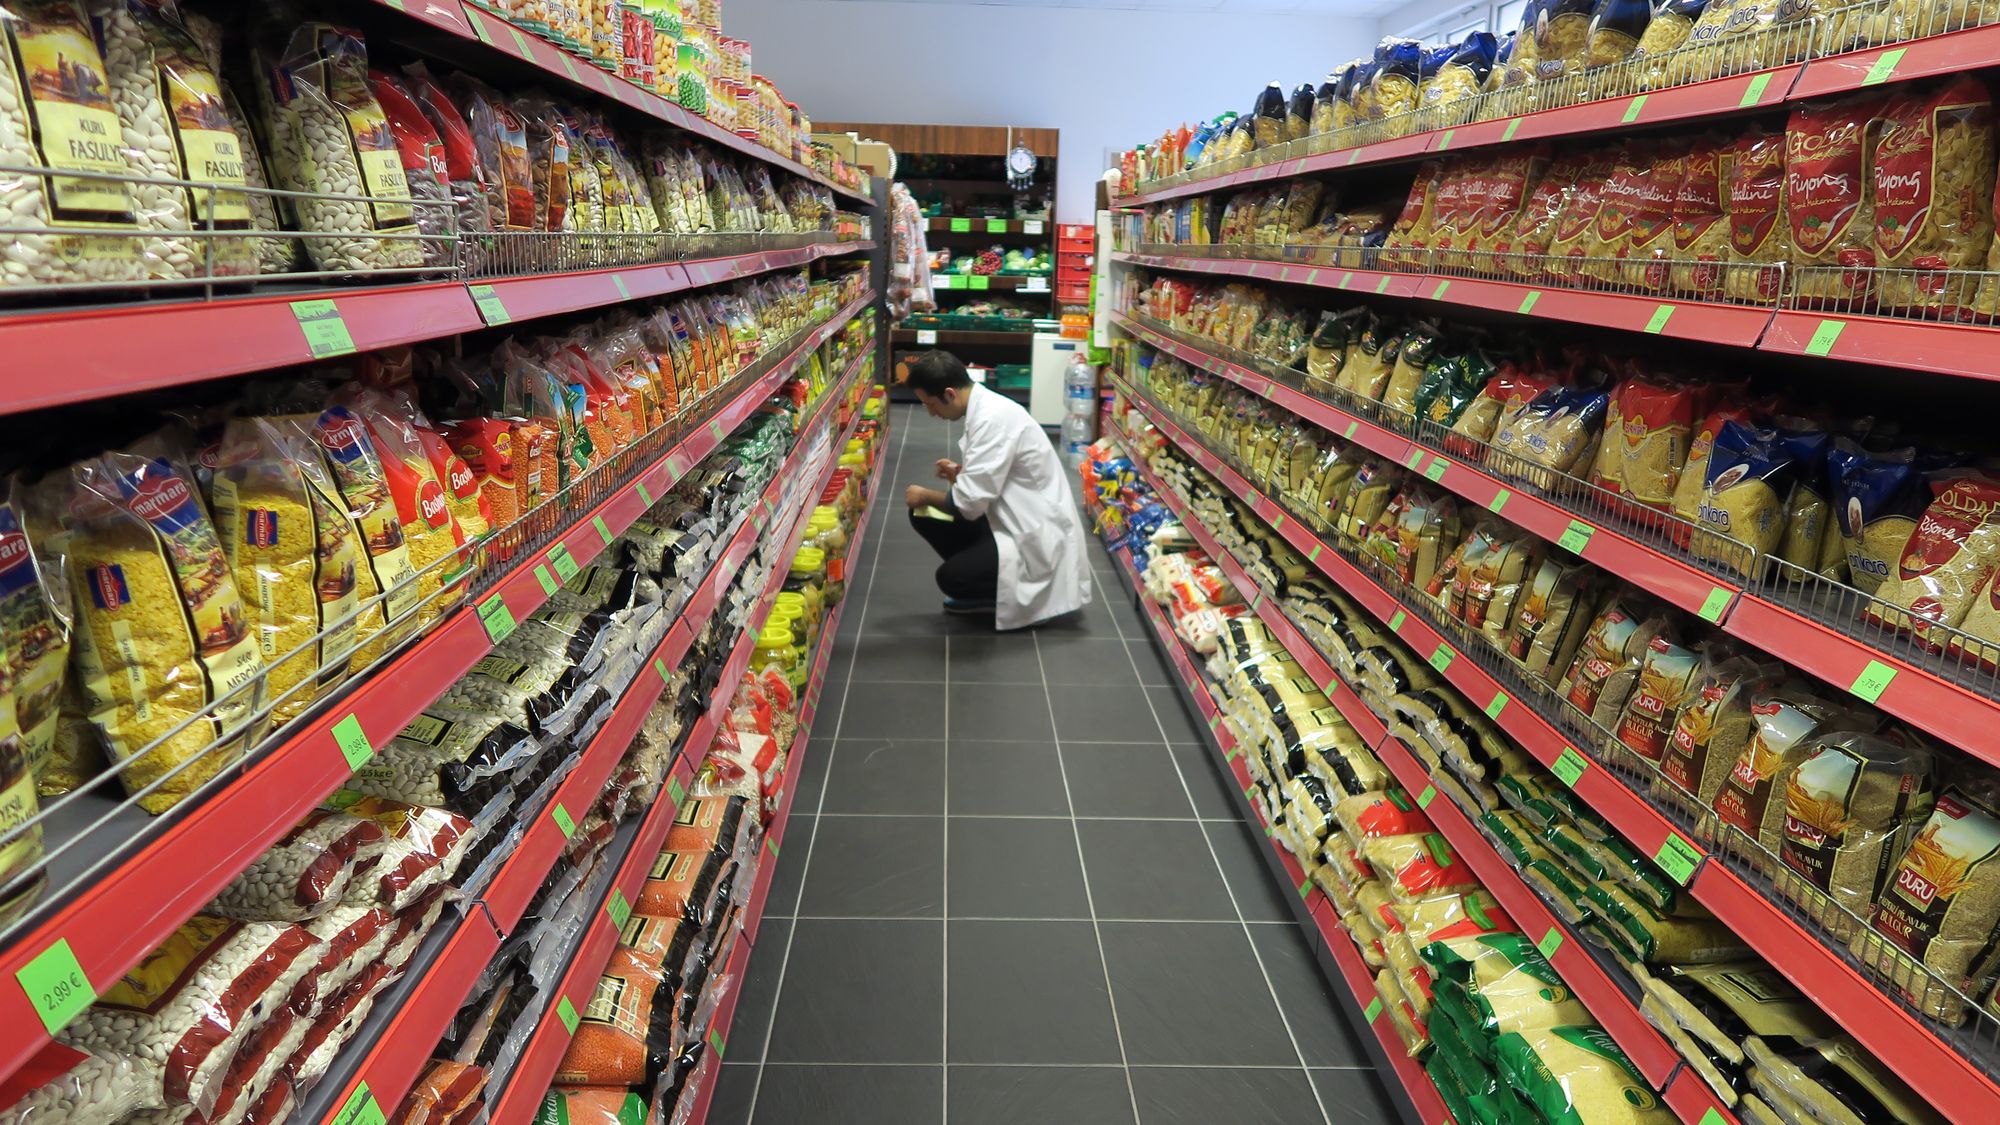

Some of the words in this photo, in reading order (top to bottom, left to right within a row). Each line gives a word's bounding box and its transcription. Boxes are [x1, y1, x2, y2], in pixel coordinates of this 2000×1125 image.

[79, 118, 107, 137] KURU
[213, 142, 234, 156] KURU
[133, 481, 187, 516] marmara
[257, 508, 267, 547] marmara
[99, 565, 118, 608] marmara
[1899, 868, 1935, 900] DURU
[1880, 909, 1913, 940] BULGUR
[43, 979, 71, 1012] 2,99
[69, 970, 82, 989] €
